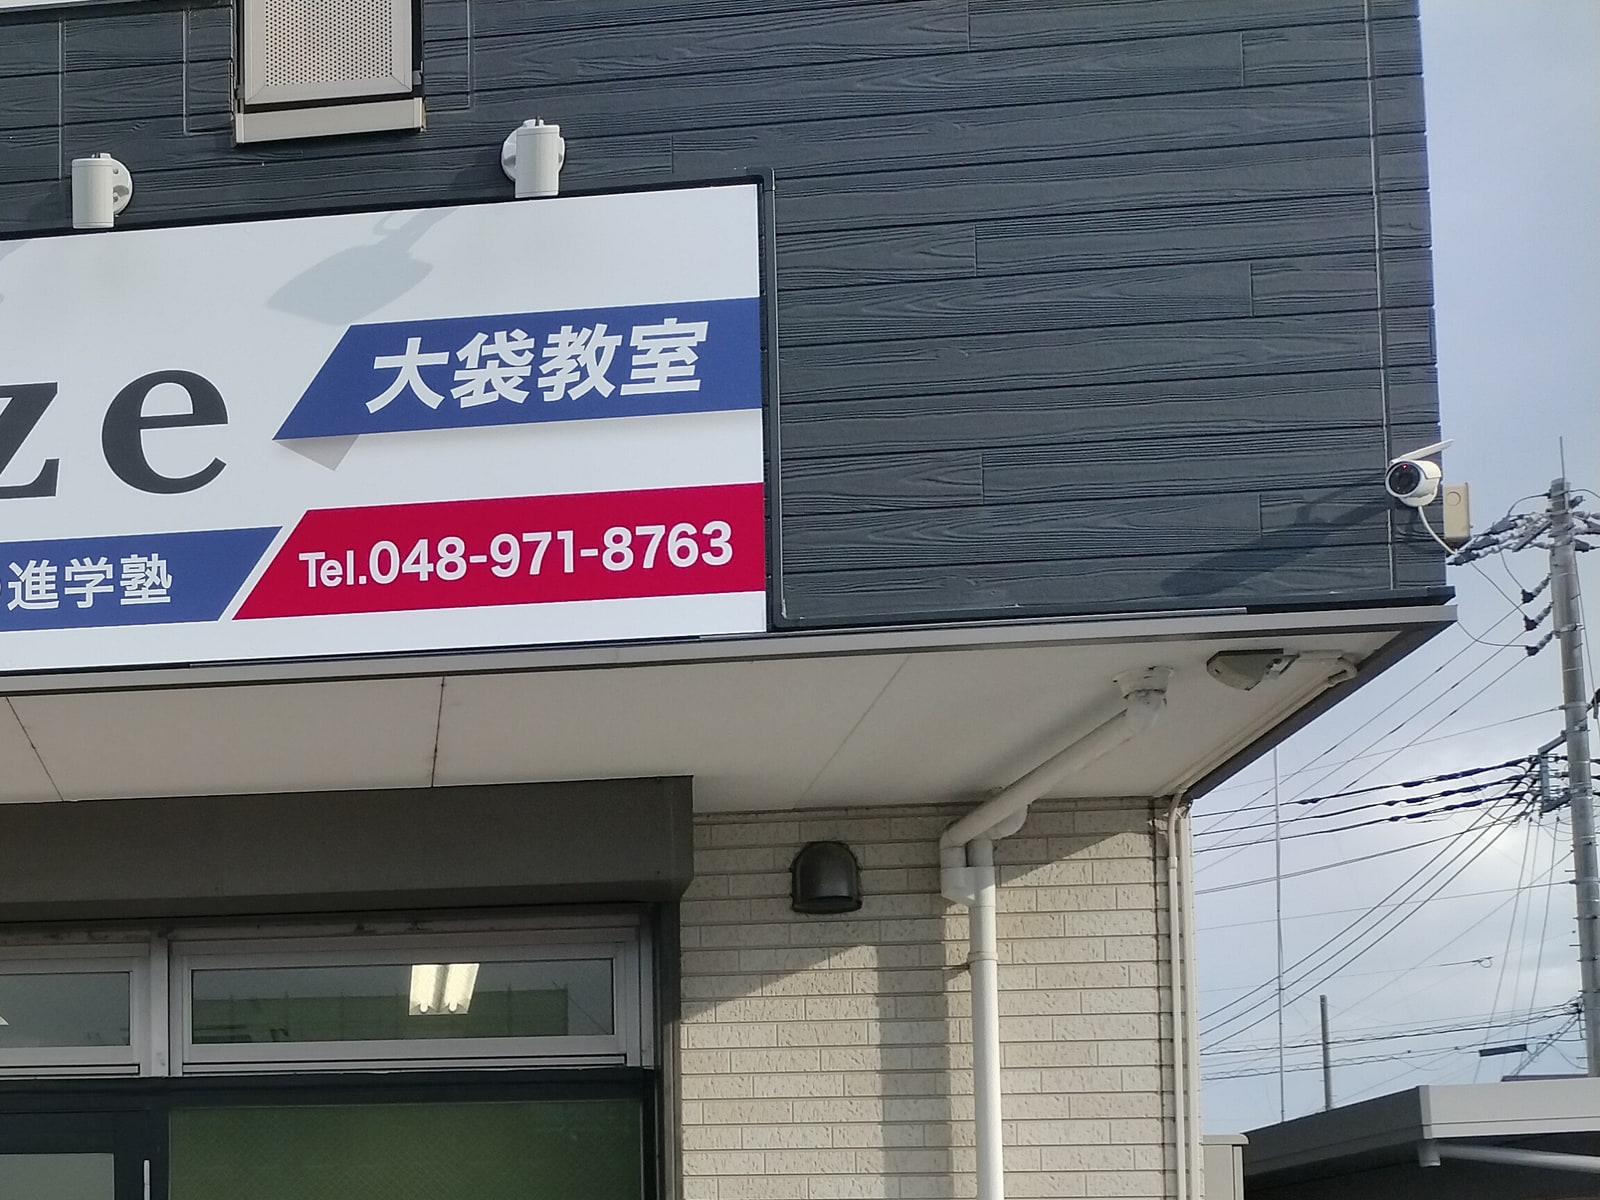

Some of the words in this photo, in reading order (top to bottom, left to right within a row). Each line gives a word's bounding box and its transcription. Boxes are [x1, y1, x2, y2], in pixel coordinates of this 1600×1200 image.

[365, 318, 709, 414] 大袋教室
[299, 520, 733, 588] Tel.048-971-8763
